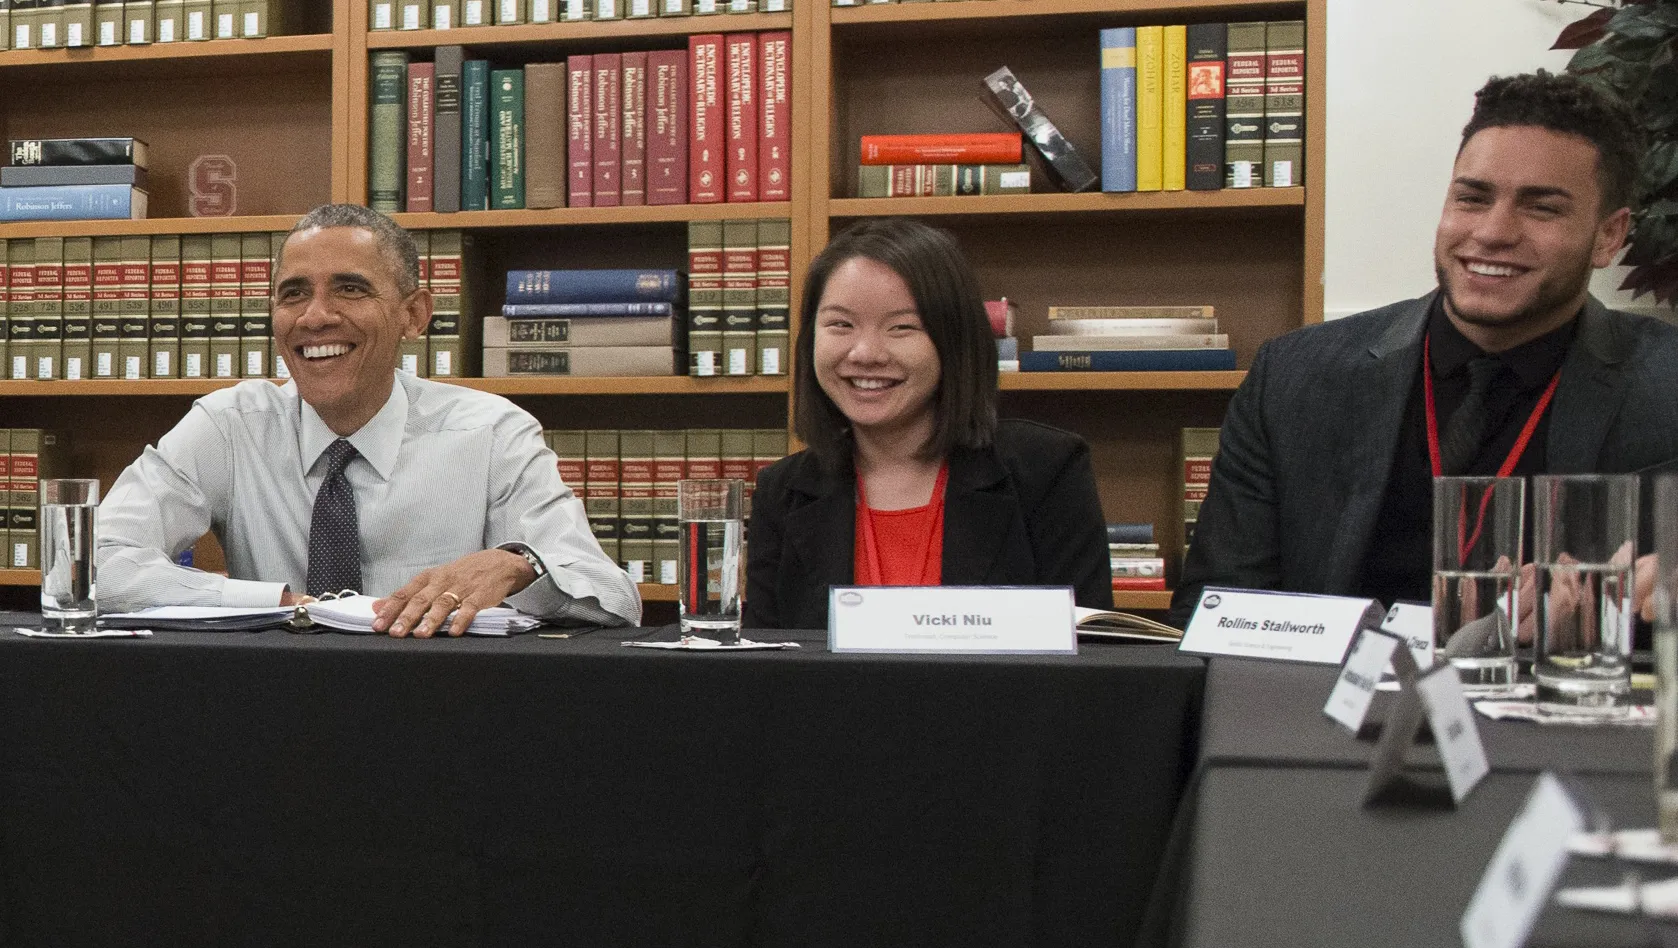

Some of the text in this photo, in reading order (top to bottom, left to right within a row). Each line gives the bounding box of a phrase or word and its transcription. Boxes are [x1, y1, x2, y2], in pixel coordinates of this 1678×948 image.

[696, 45, 705, 94] DICTIONARY
[706, 44, 716, 106] ENCYCLOPEDIC
[730, 43, 741, 92] DICTIONARY
[741, 42, 751, 105] ENCYCLOPEDIC
[765, 42, 775, 90] DICTIONARY
[775, 40, 785, 103] ENCYCLOPEDIC
[1146, 54, 1155, 94] ZOHAR
[1171, 53, 1181, 93] ZOHAR
[410, 77, 422, 146] Robinson Jeffers
[569, 70, 582, 140] Robinson Jeffers
[596, 69, 608, 139] Robinson Jeffers
[623, 67, 636, 138] Robinson Jeffers
[655, 65, 668, 134] Robinson Jeffers
[696, 101, 705, 140] RELIGION
[731, 100, 741, 139] RELIGION
[765, 98, 775, 138] RELIGION
[15, 202, 73, 211] Robinson Jeffers
[99, 301, 113, 310] 491
[912, 614, 992, 626] Vicki Niu
[1217, 616, 1326, 635] Rollins Stallworth
